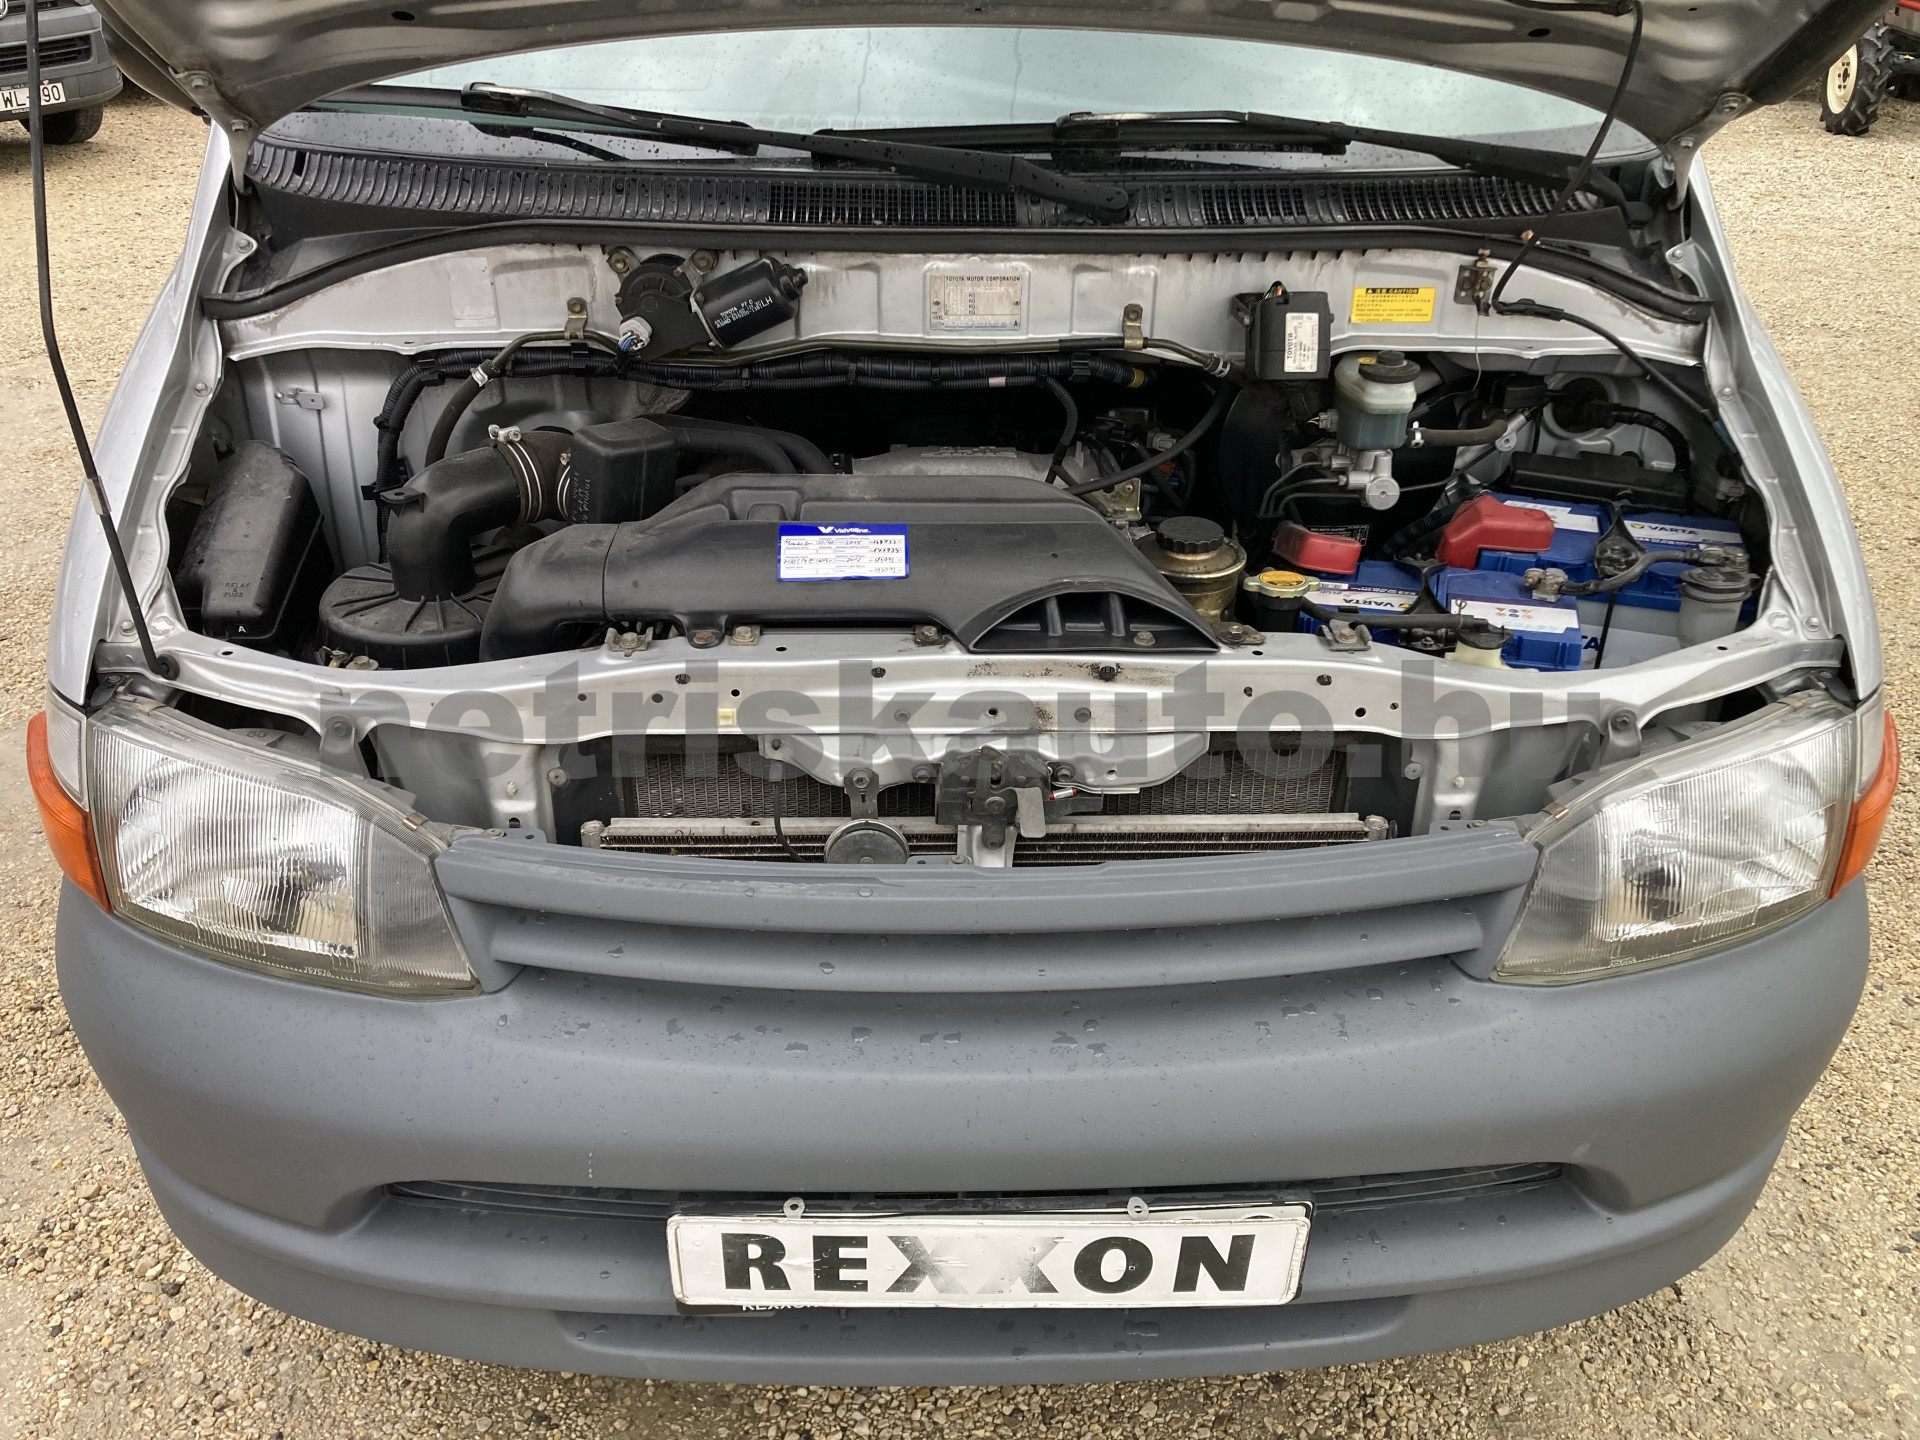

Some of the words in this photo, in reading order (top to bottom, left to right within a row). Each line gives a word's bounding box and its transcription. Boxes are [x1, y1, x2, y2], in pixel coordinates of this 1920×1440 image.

[761, 296, 773, 308] LH
[720, 306, 738, 318] TOYOTA
[1647, 524, 1699, 536] VARTA
[1342, 598, 1395, 608] VARTA
[238, 625, 247, 633] A
[720, 1232, 1257, 1294] REXXON
